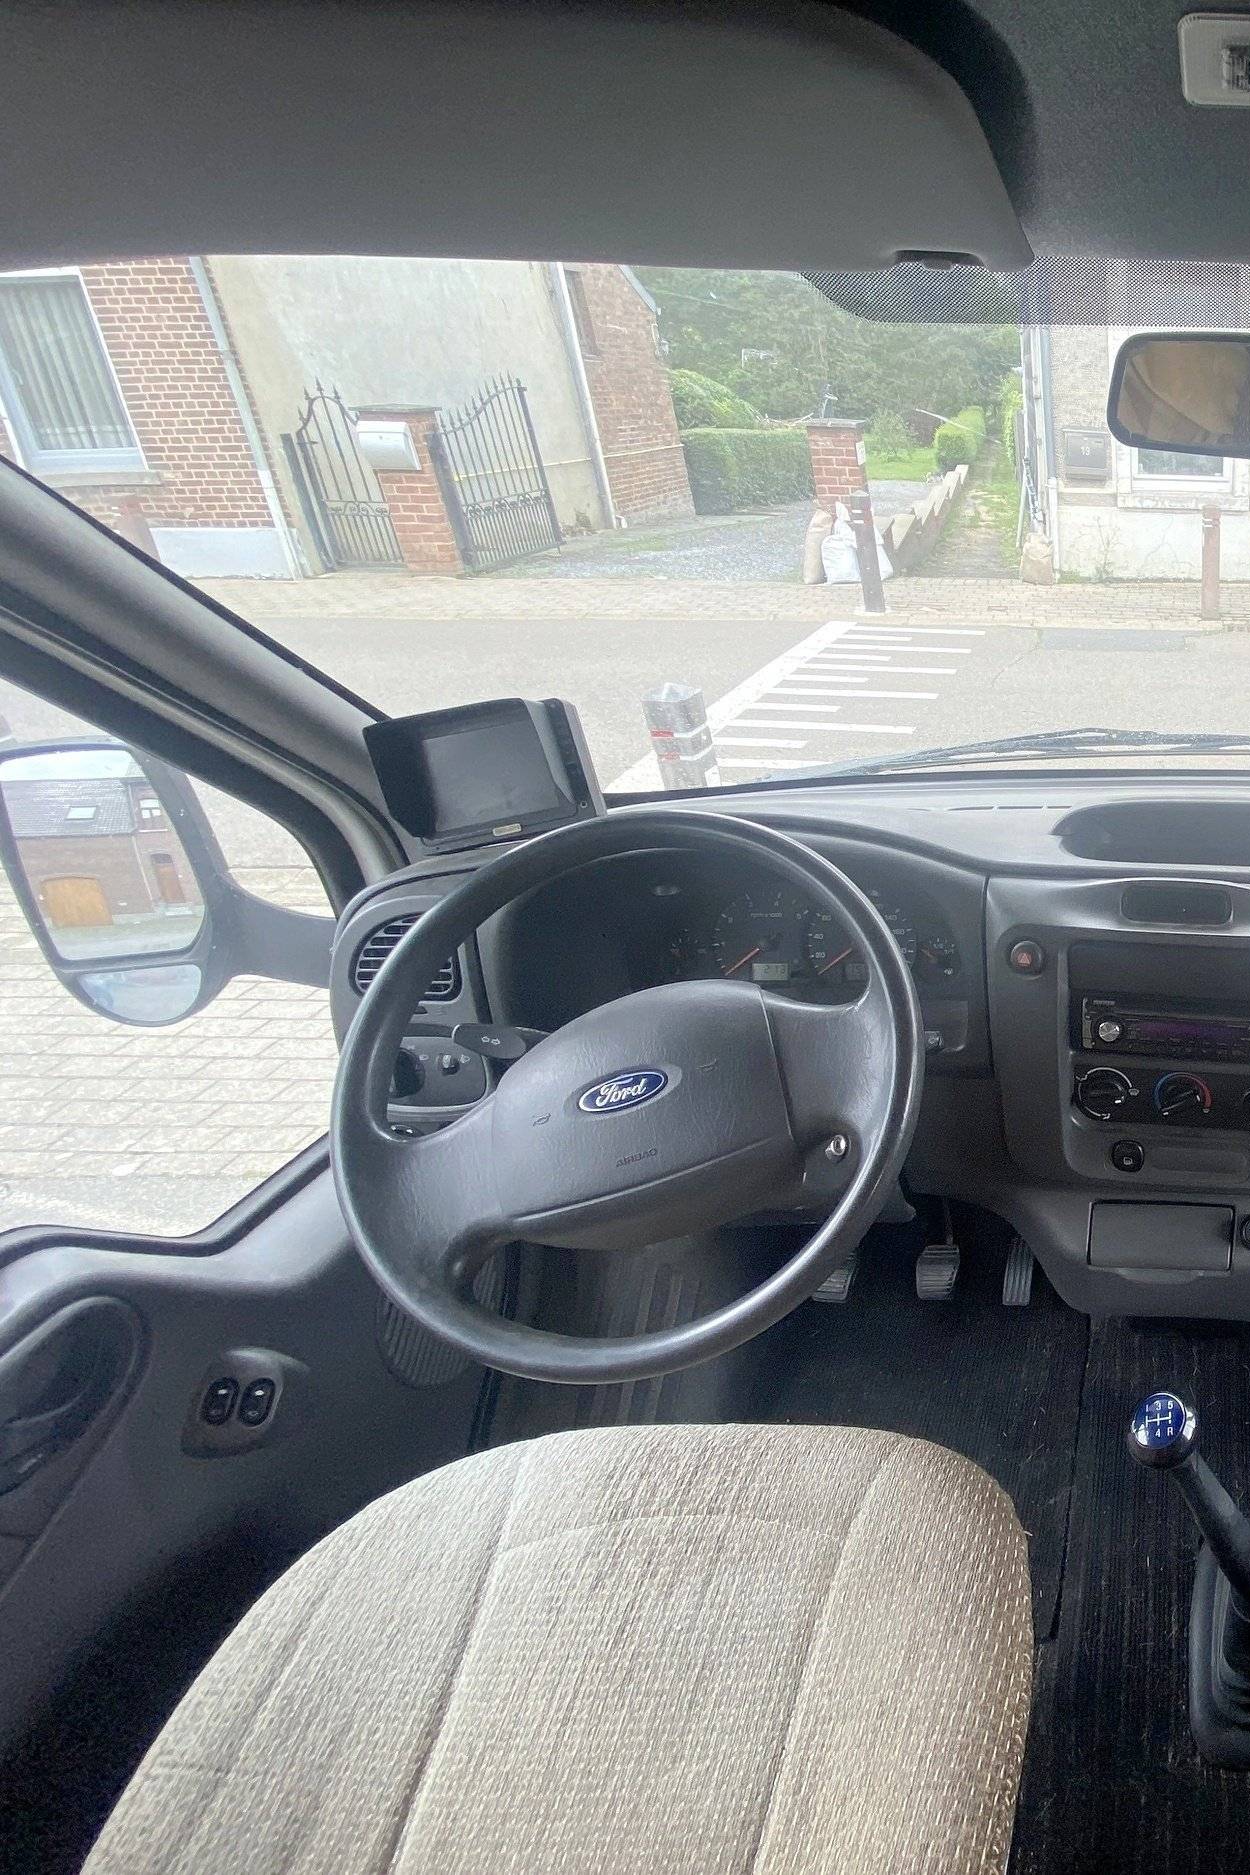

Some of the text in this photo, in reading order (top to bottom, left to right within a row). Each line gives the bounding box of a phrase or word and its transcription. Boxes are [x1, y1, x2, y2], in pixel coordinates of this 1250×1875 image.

[595, 1077, 648, 1108] Ford
[1154, 1400, 1162, 1411] 3
[1167, 1400, 1174, 1410] 5
[1155, 1428, 1161, 1438] 4
[1167, 1427, 1174, 1437] R
